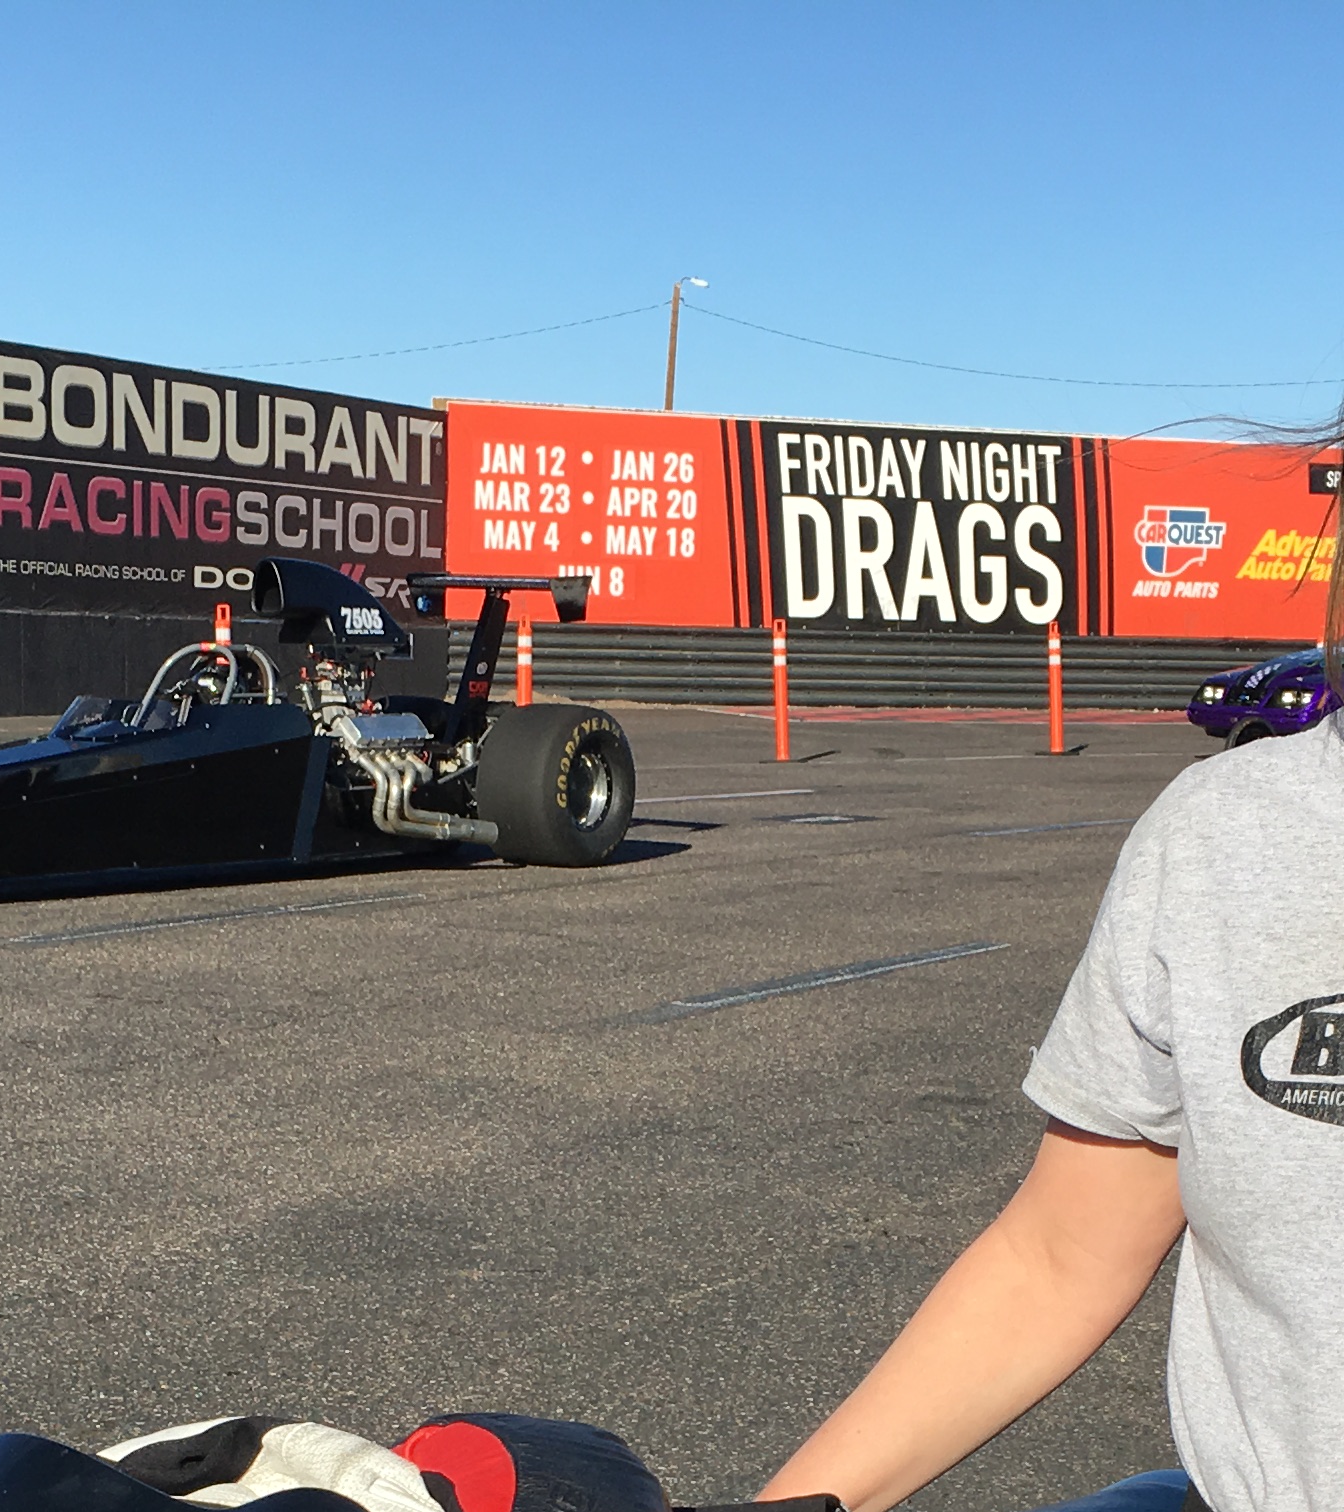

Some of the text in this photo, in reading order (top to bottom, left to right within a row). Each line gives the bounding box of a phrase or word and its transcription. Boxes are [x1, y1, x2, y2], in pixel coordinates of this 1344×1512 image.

[480, 442, 694, 483] JAN 12 JAN 26
[777, 433, 1062, 504] FRIDAY NIGHT
[474, 480, 697, 520] MAR 23 APR 20
[484, 519, 695, 558] MAY 4 MAY 18
[1136, 522, 1224, 546] CARQUEST
[20, 559, 73, 577] OFFICIAL
[75, 563, 120, 579] RACING
[122, 565, 169, 582] SCHOOL
[171, 569, 186, 583] OF
[782, 495, 1064, 625] DRAGS
[1235, 555, 1296, 582] Auto
[609, 566, 624, 597] 8
[1132, 579, 1220, 599] AUTO PARTS
